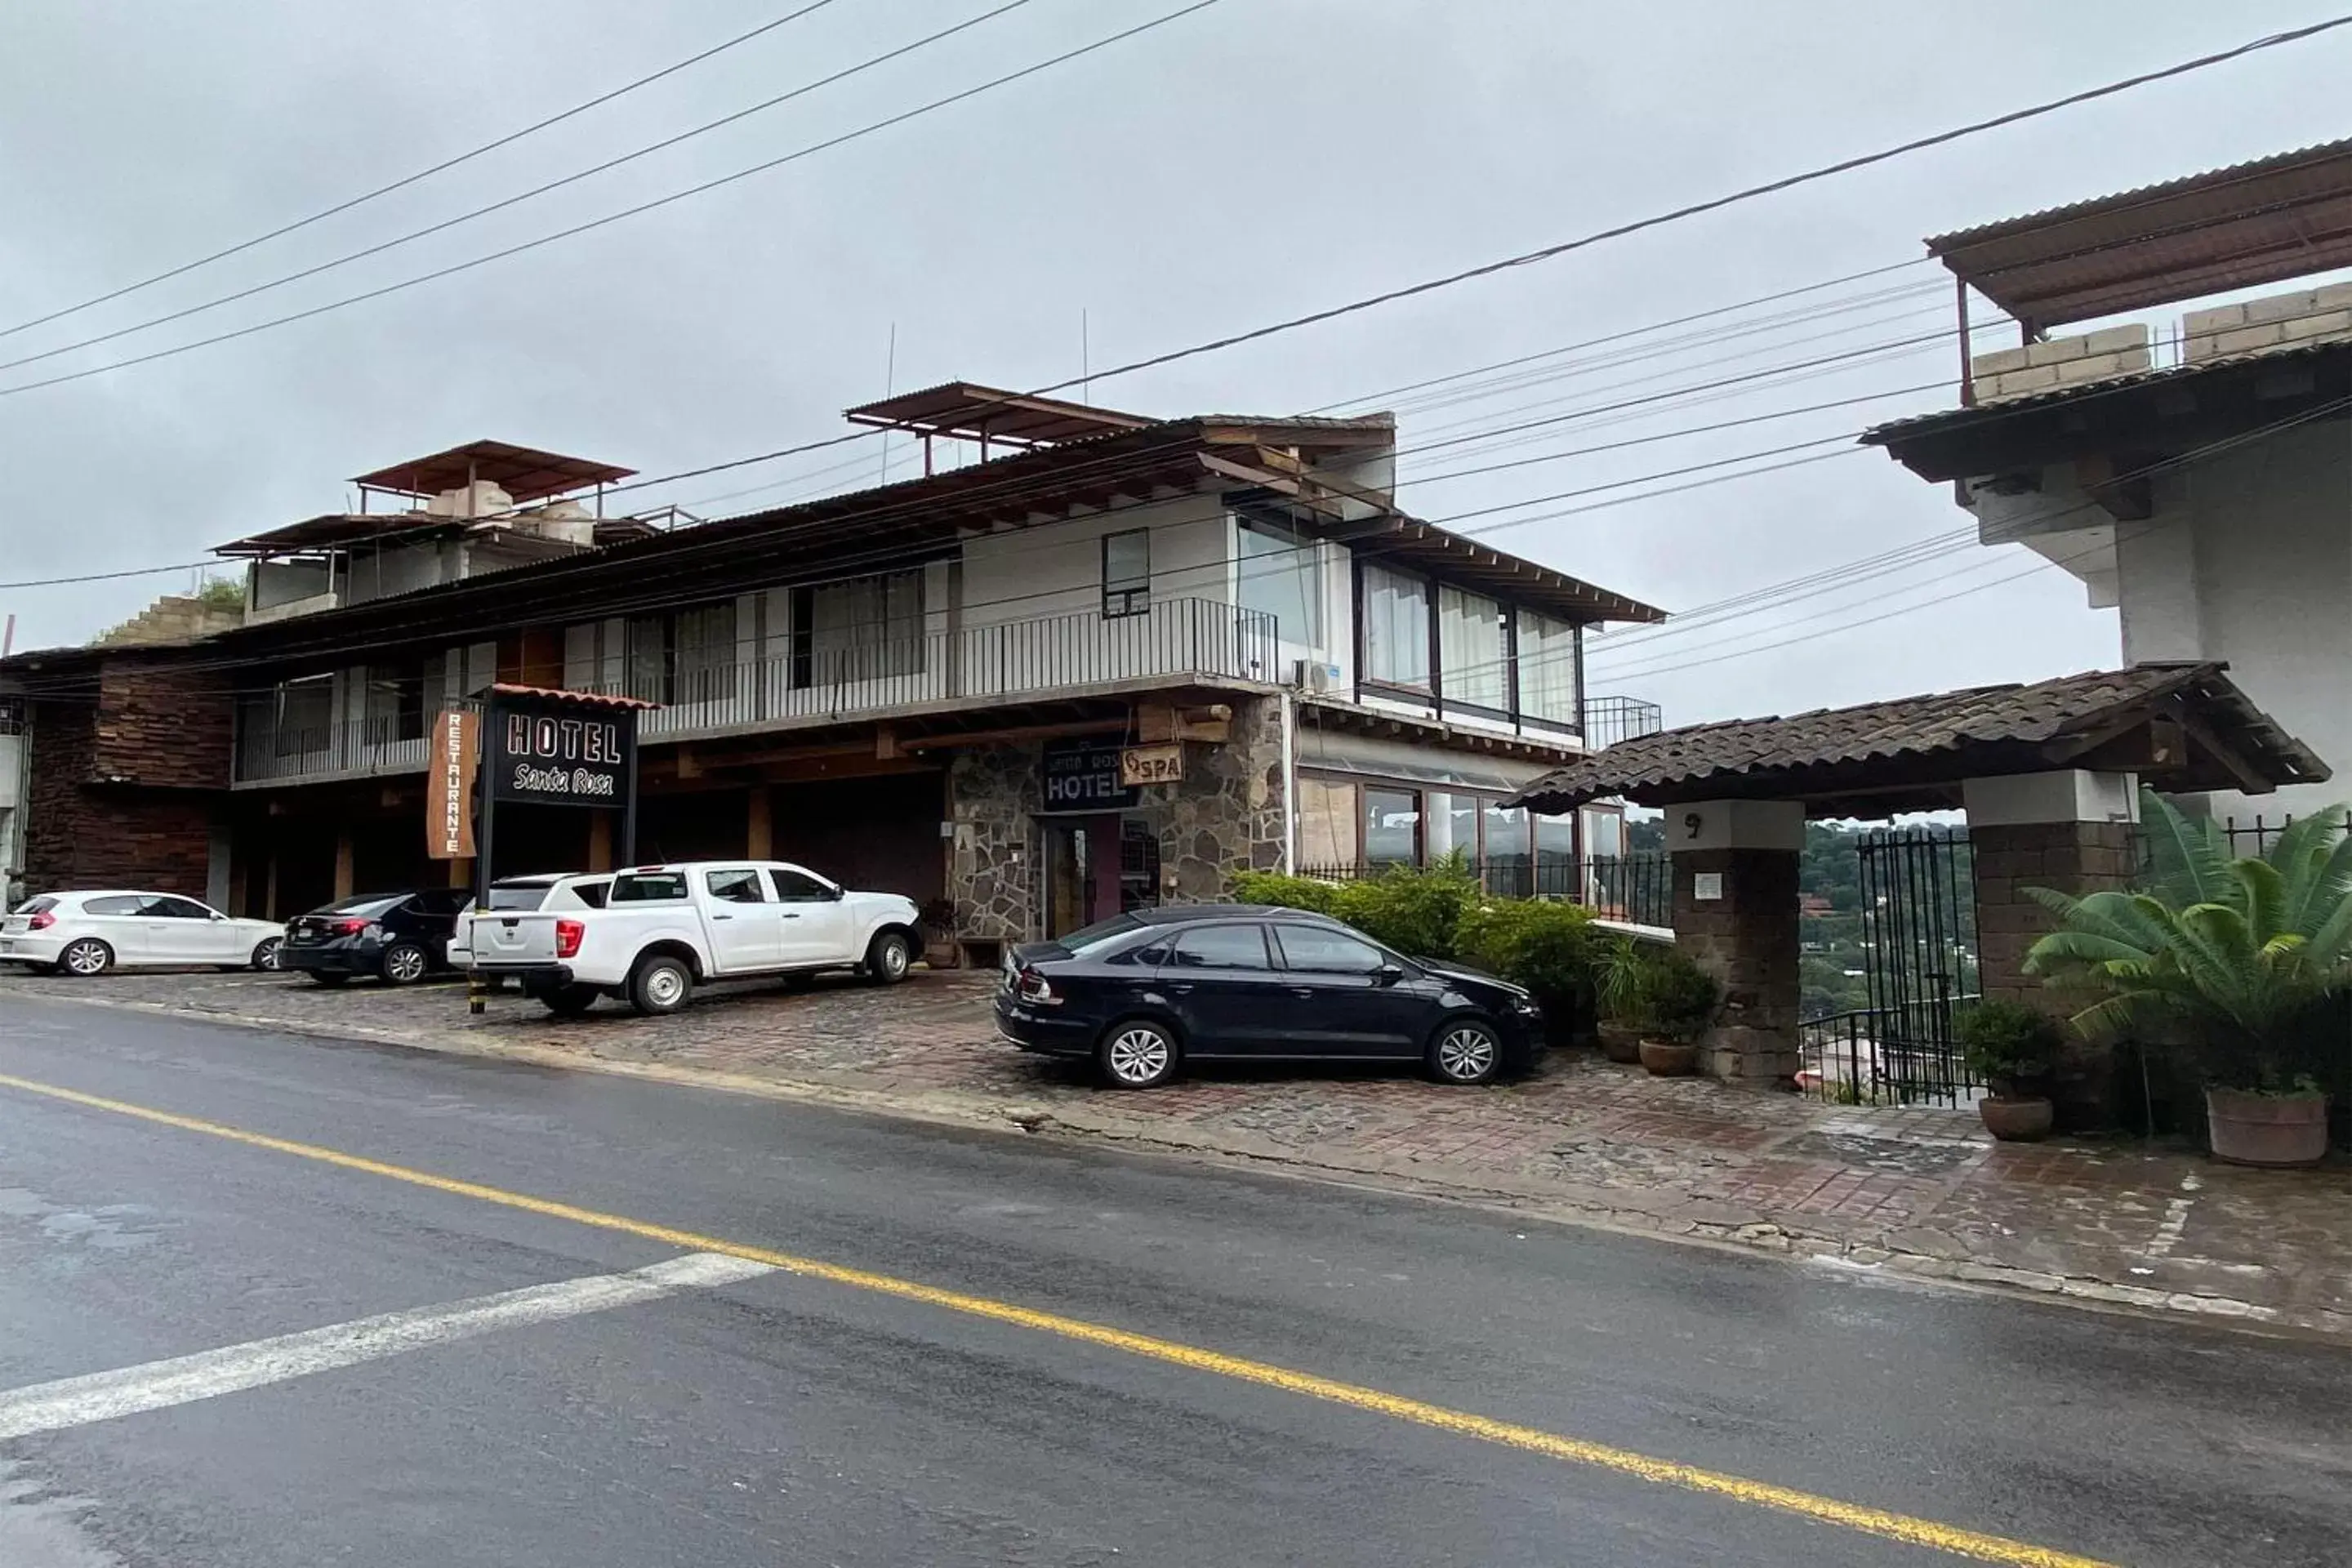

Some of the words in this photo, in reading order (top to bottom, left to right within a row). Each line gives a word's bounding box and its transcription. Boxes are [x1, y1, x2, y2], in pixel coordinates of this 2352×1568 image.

[507, 714, 621, 765] HOTEL
[446, 714, 461, 853] RESTAURANTE
[513, 763, 569, 793] Santa
[572, 766, 614, 796] Rosa
[1048, 773, 1127, 800] HOTEL
[1685, 813, 1701, 839] 9
